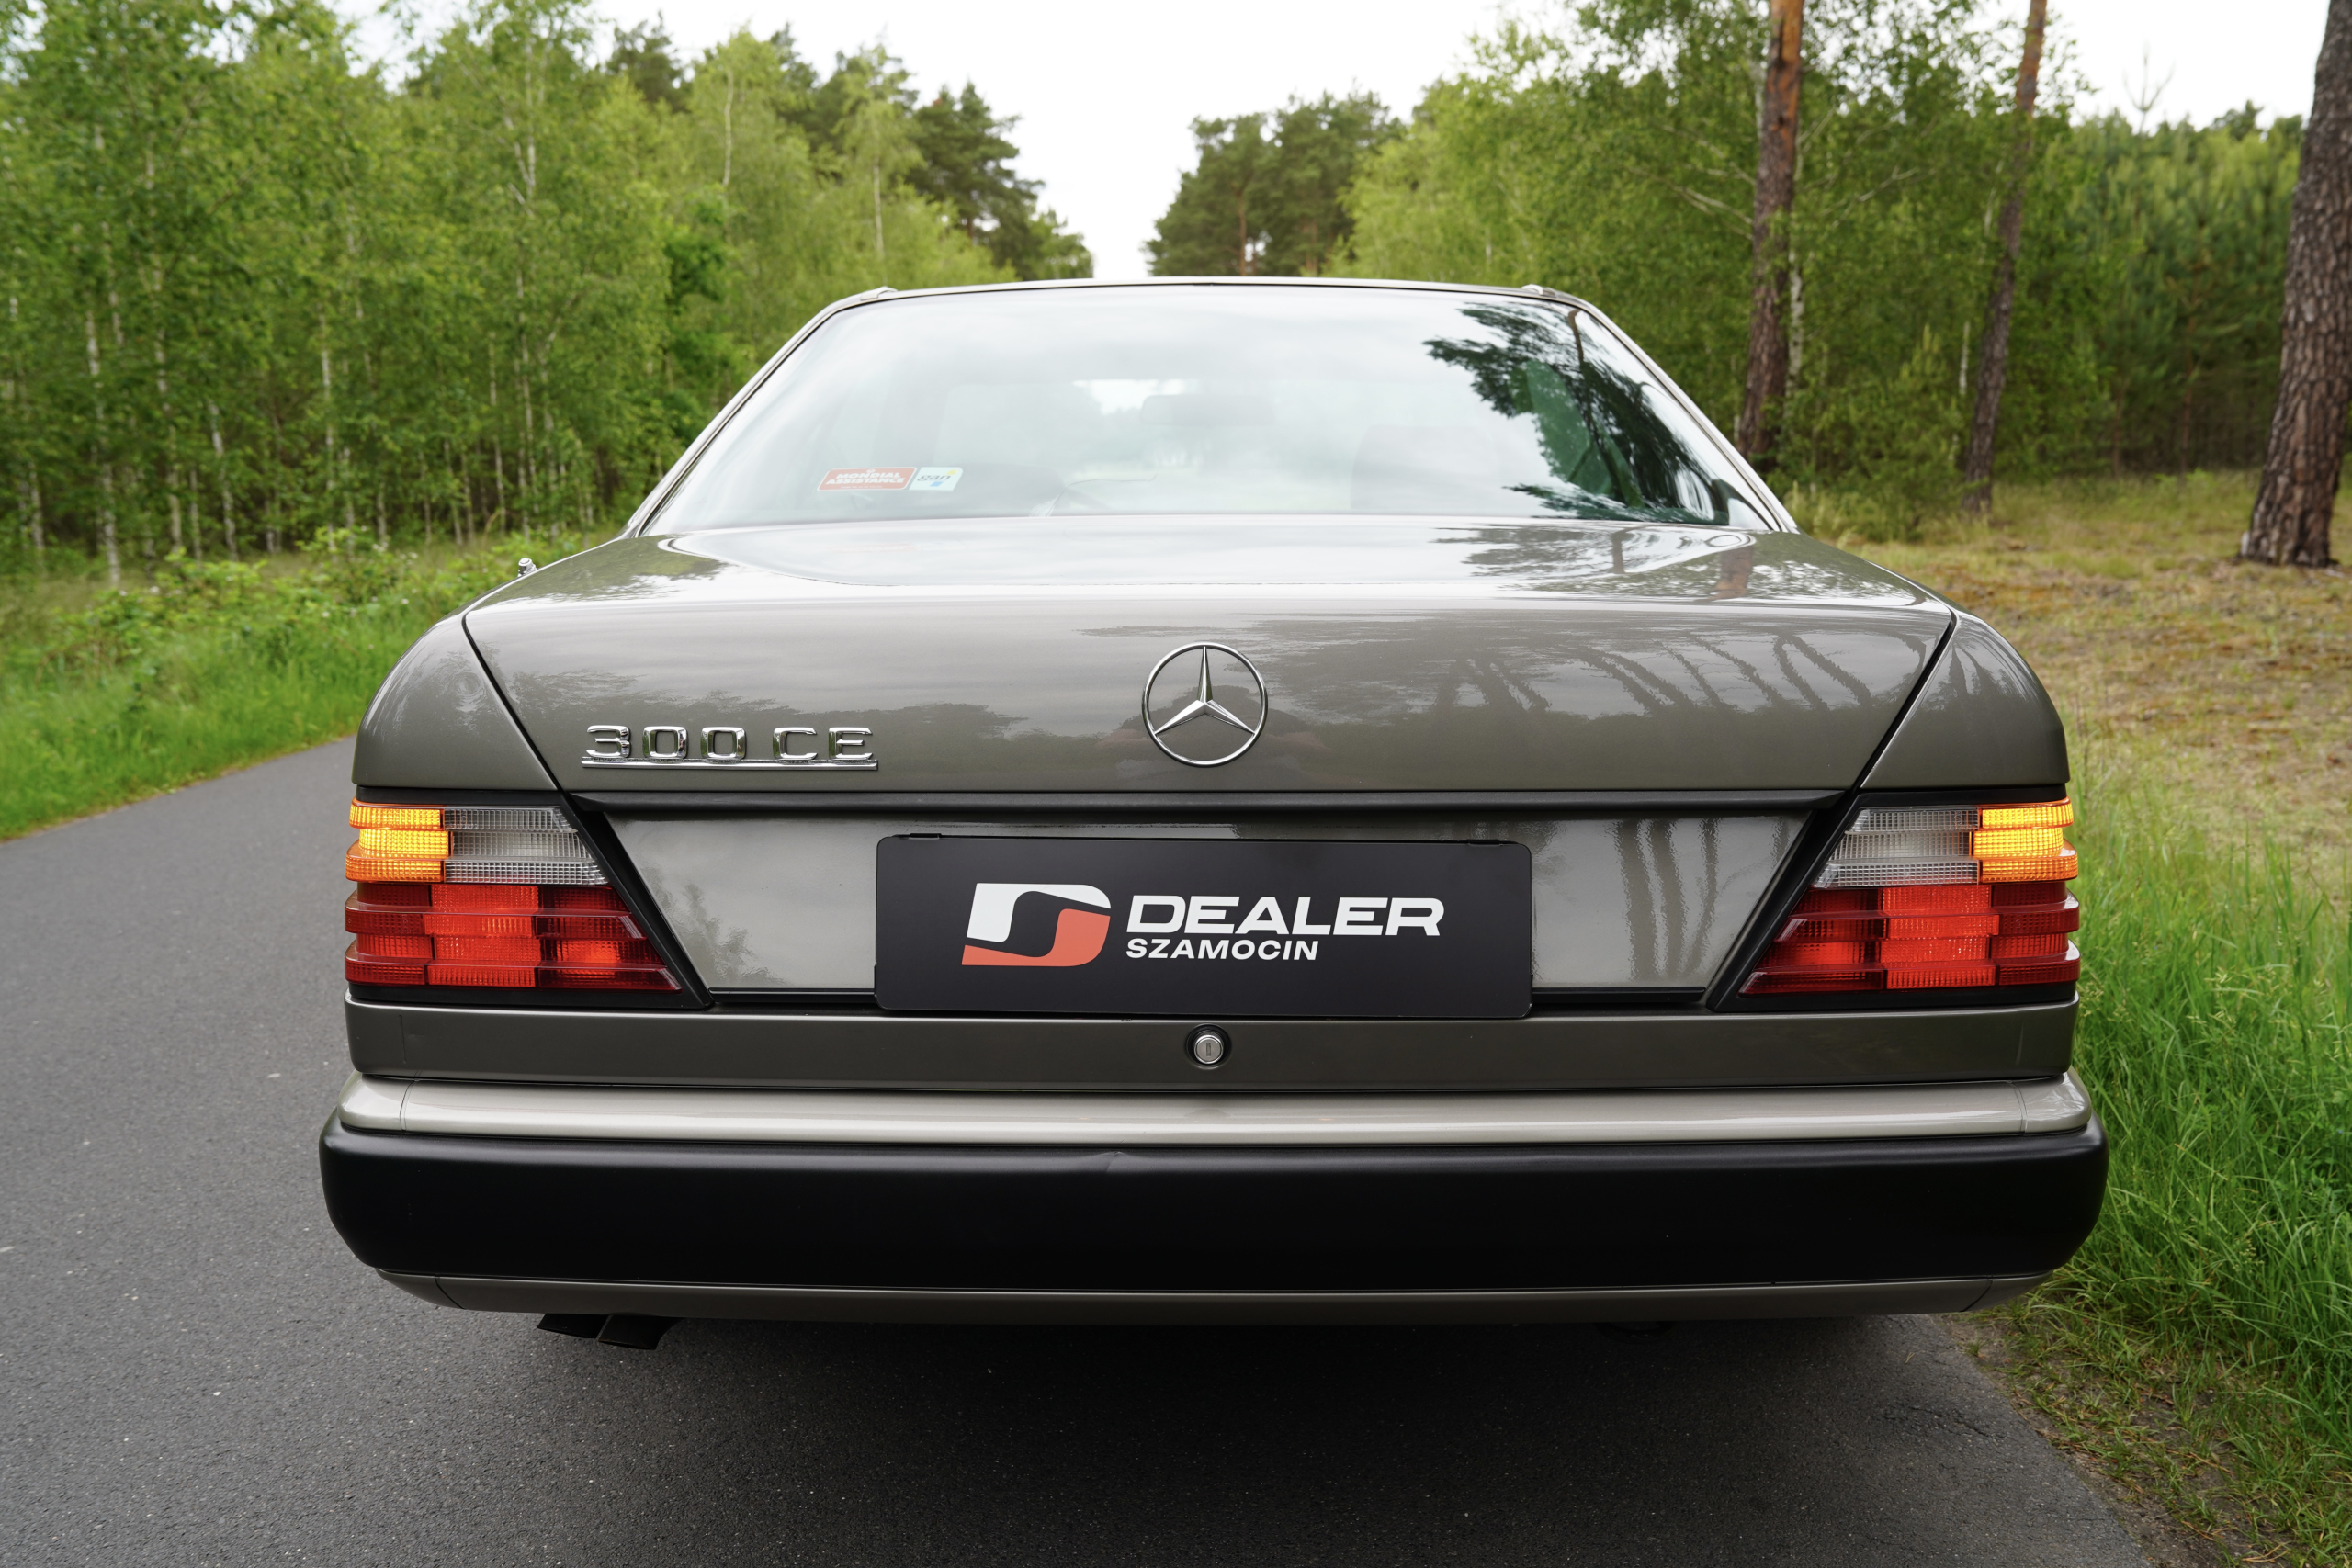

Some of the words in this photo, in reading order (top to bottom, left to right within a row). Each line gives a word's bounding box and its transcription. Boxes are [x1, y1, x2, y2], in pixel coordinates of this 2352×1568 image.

[917, 474, 952, 482] gan
[586, 725, 747, 760] 300
[773, 727, 873, 760] CE
[1126, 895, 1444, 936] DEALER
[1125, 938, 1319, 961] SZAMOCIN
